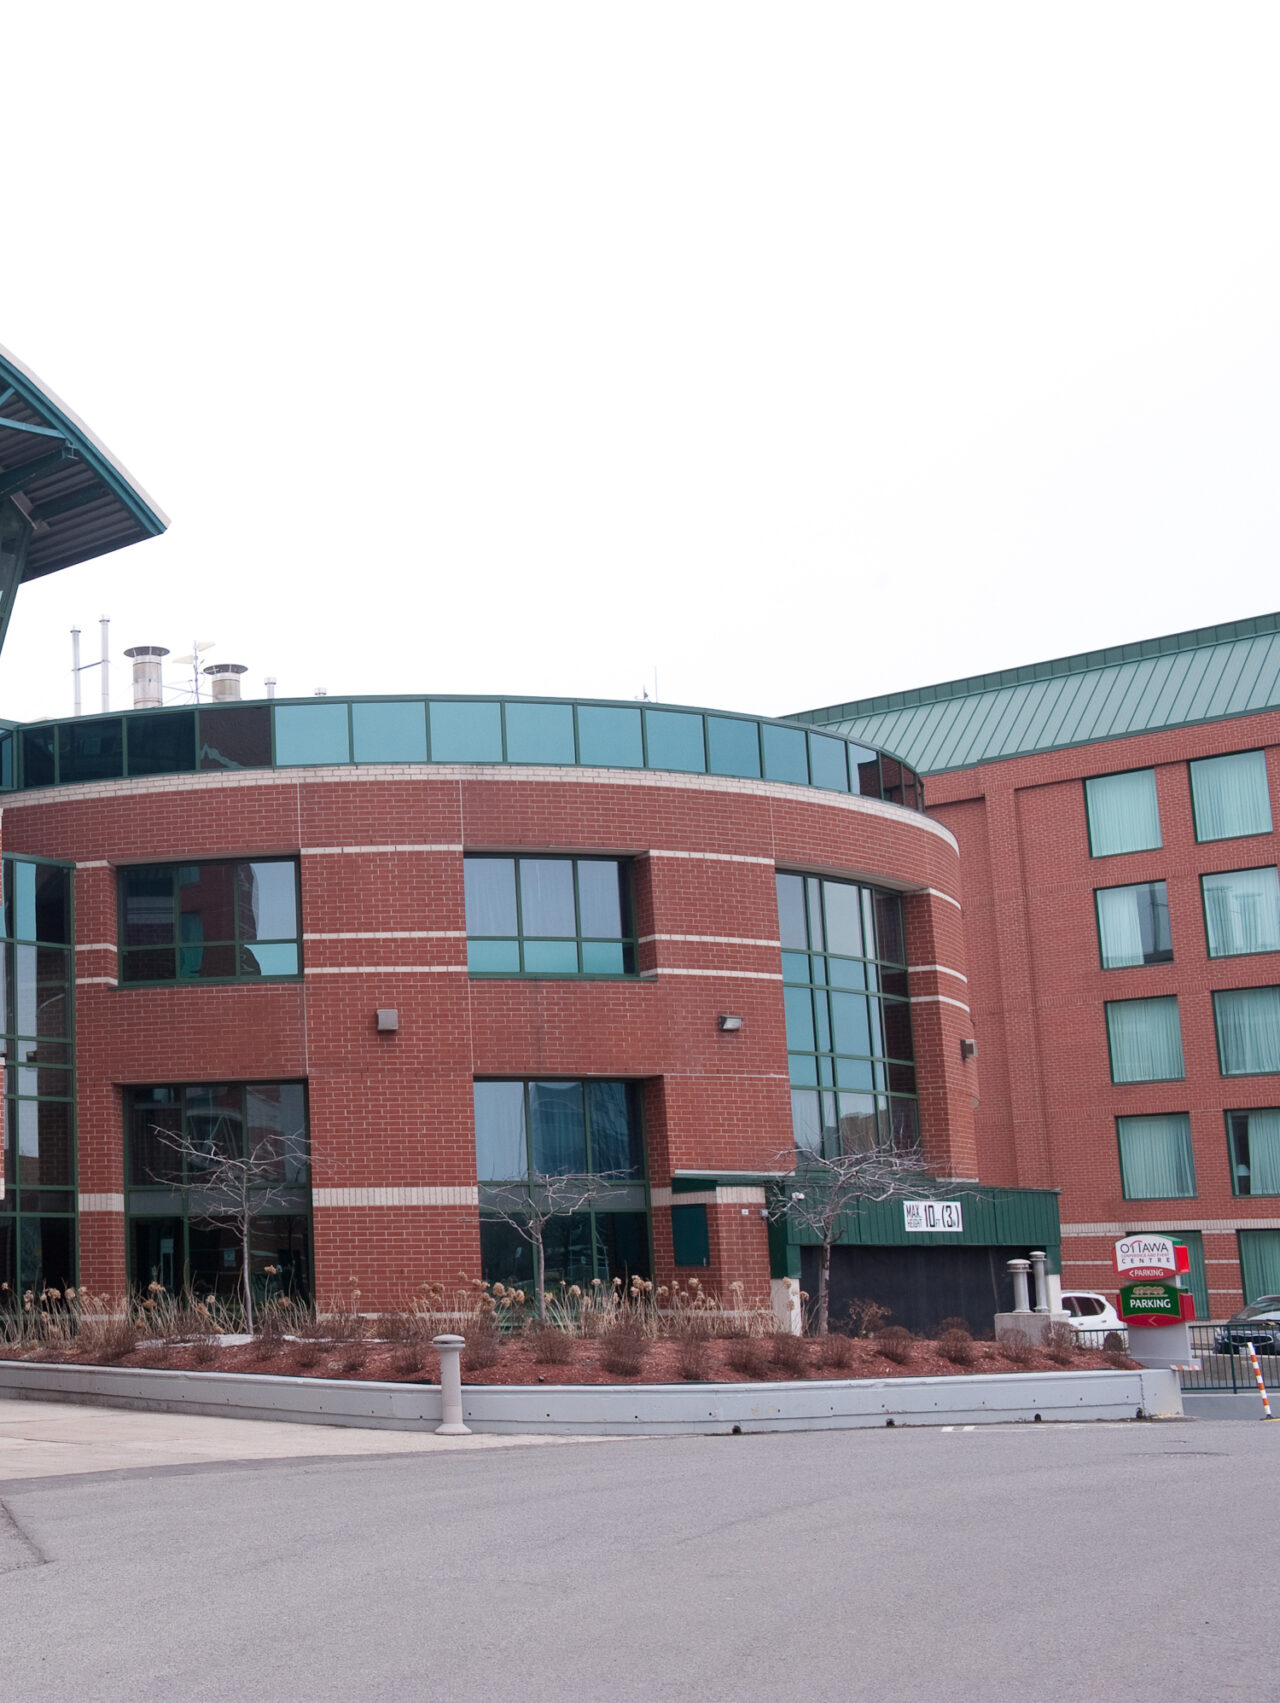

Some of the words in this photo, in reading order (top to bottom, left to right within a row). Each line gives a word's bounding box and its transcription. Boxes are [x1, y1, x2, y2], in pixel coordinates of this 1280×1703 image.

[1120, 1240, 1169, 1254] OTTAWA
[1134, 1269, 1164, 1277] PARKING
[1130, 1298, 1171, 1309] PARKING
